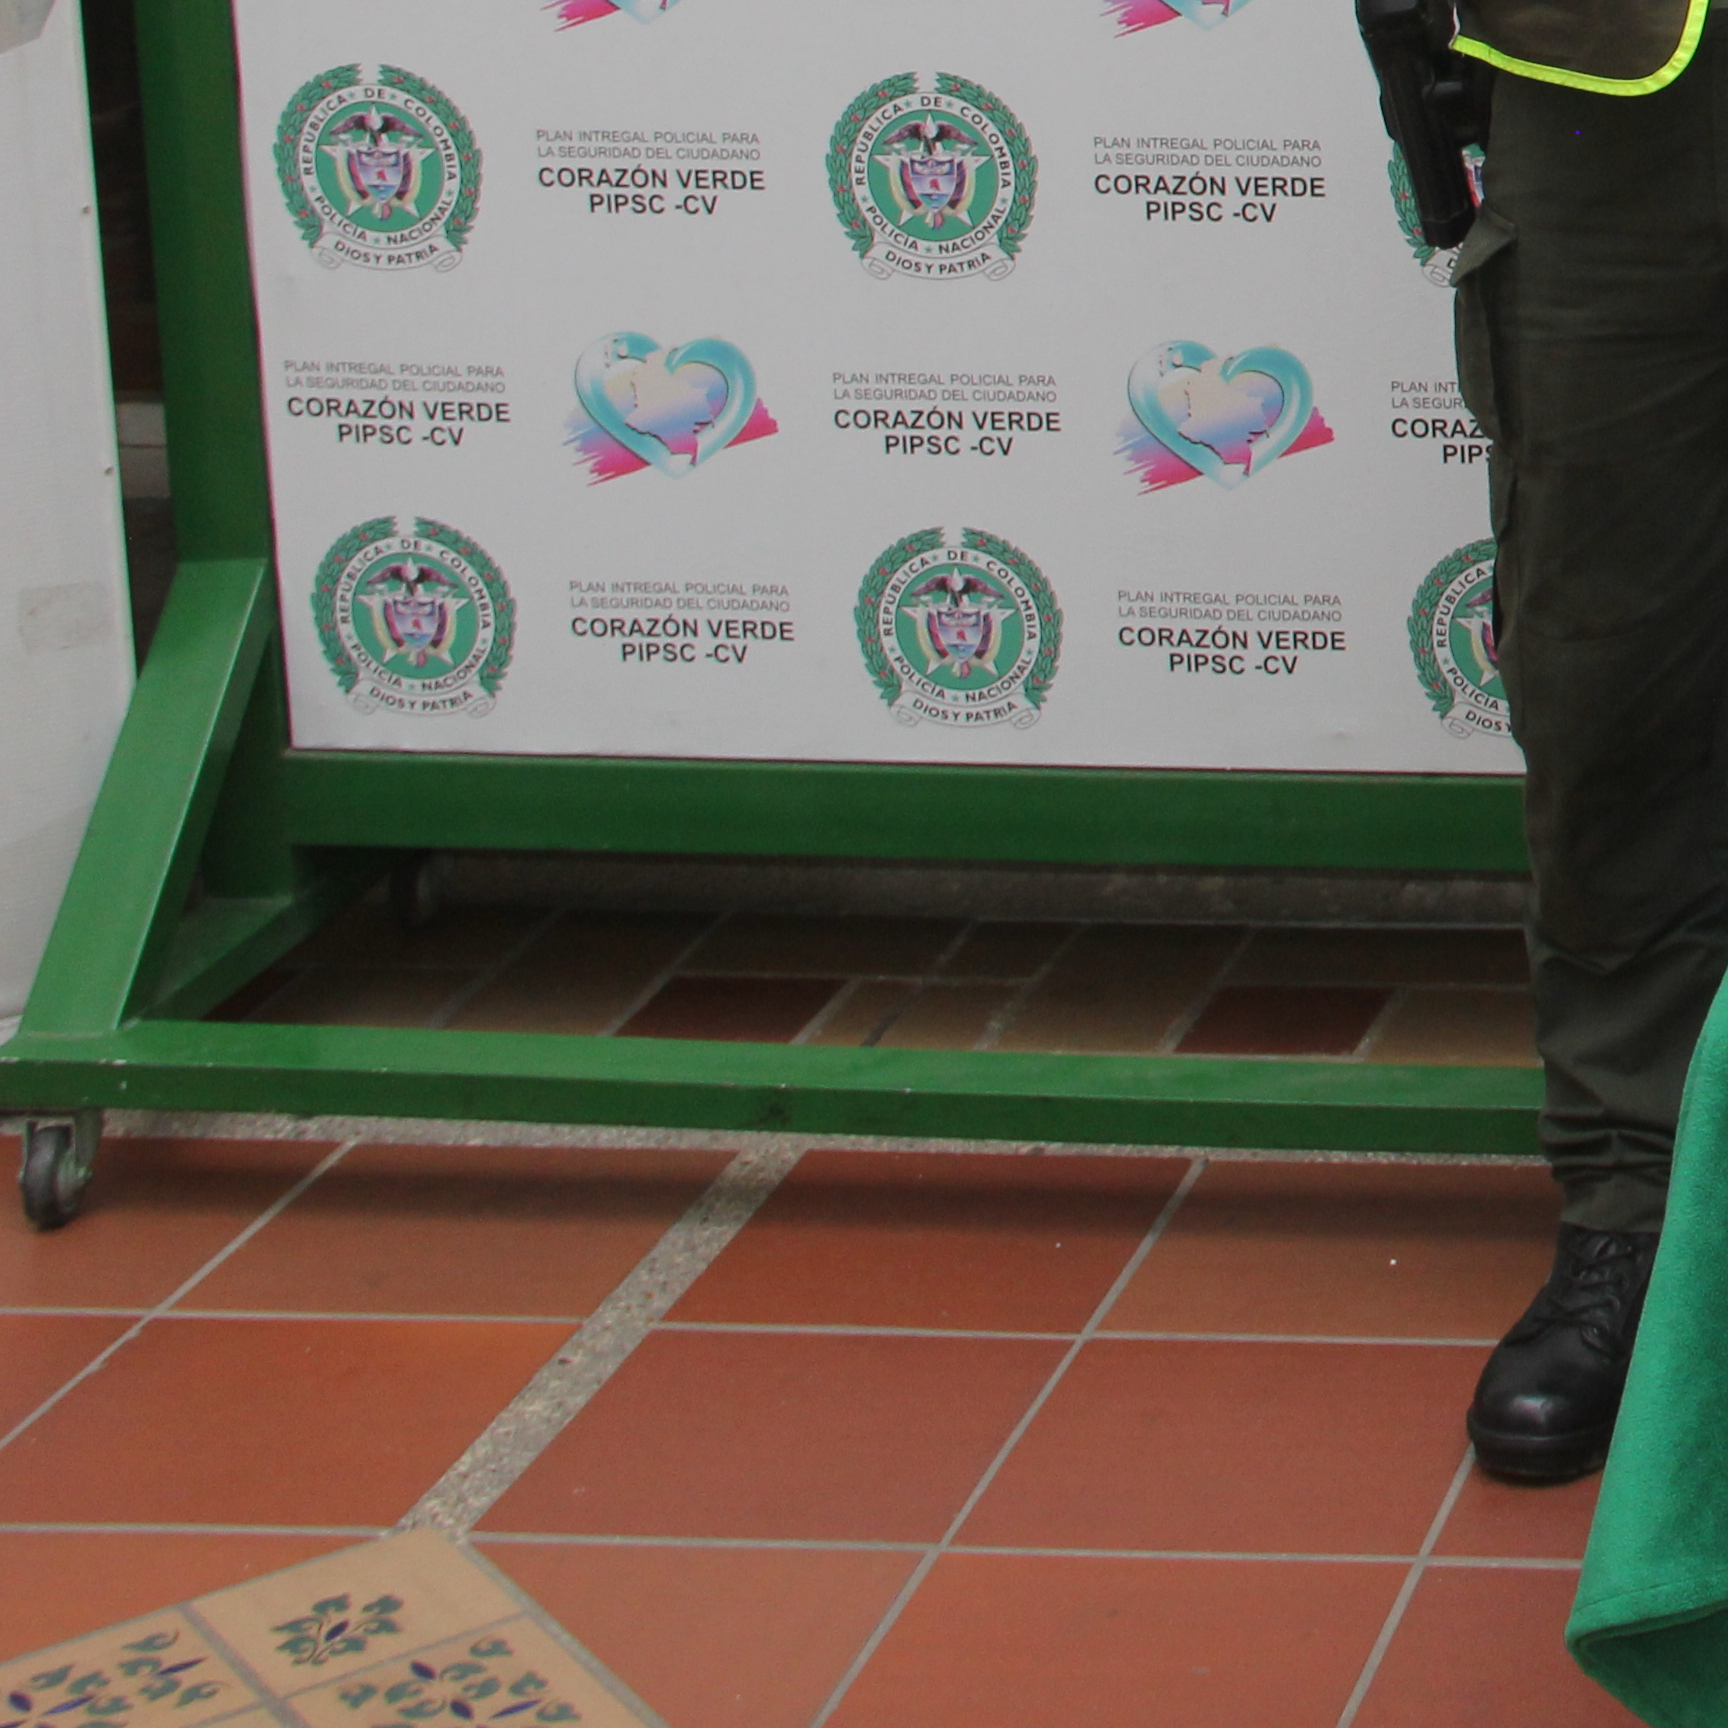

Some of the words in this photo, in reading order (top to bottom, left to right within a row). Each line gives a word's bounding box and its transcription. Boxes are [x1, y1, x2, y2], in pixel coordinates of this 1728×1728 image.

[537, 163, 668, 189] CORAZÓN
[675, 169, 766, 191] VERDE
[588, 193, 665, 215] PIPSC
[832, 372, 869, 384] PLAN
[875, 373, 945, 385] INTREGAL
[950, 374, 1014, 386] POLICIAL
[1018, 374, 1056, 387] PARA
[834, 389, 851, 400] LA
[854, 388, 937, 400] SEGURIDAD
[942, 389, 968, 401] DEL
[972, 390, 1057, 403] CIUDADANO
[834, 405, 964, 430] CORAZÓN
[971, 410, 1062, 432] VERDE
[884, 435, 961, 456] PIPSC
